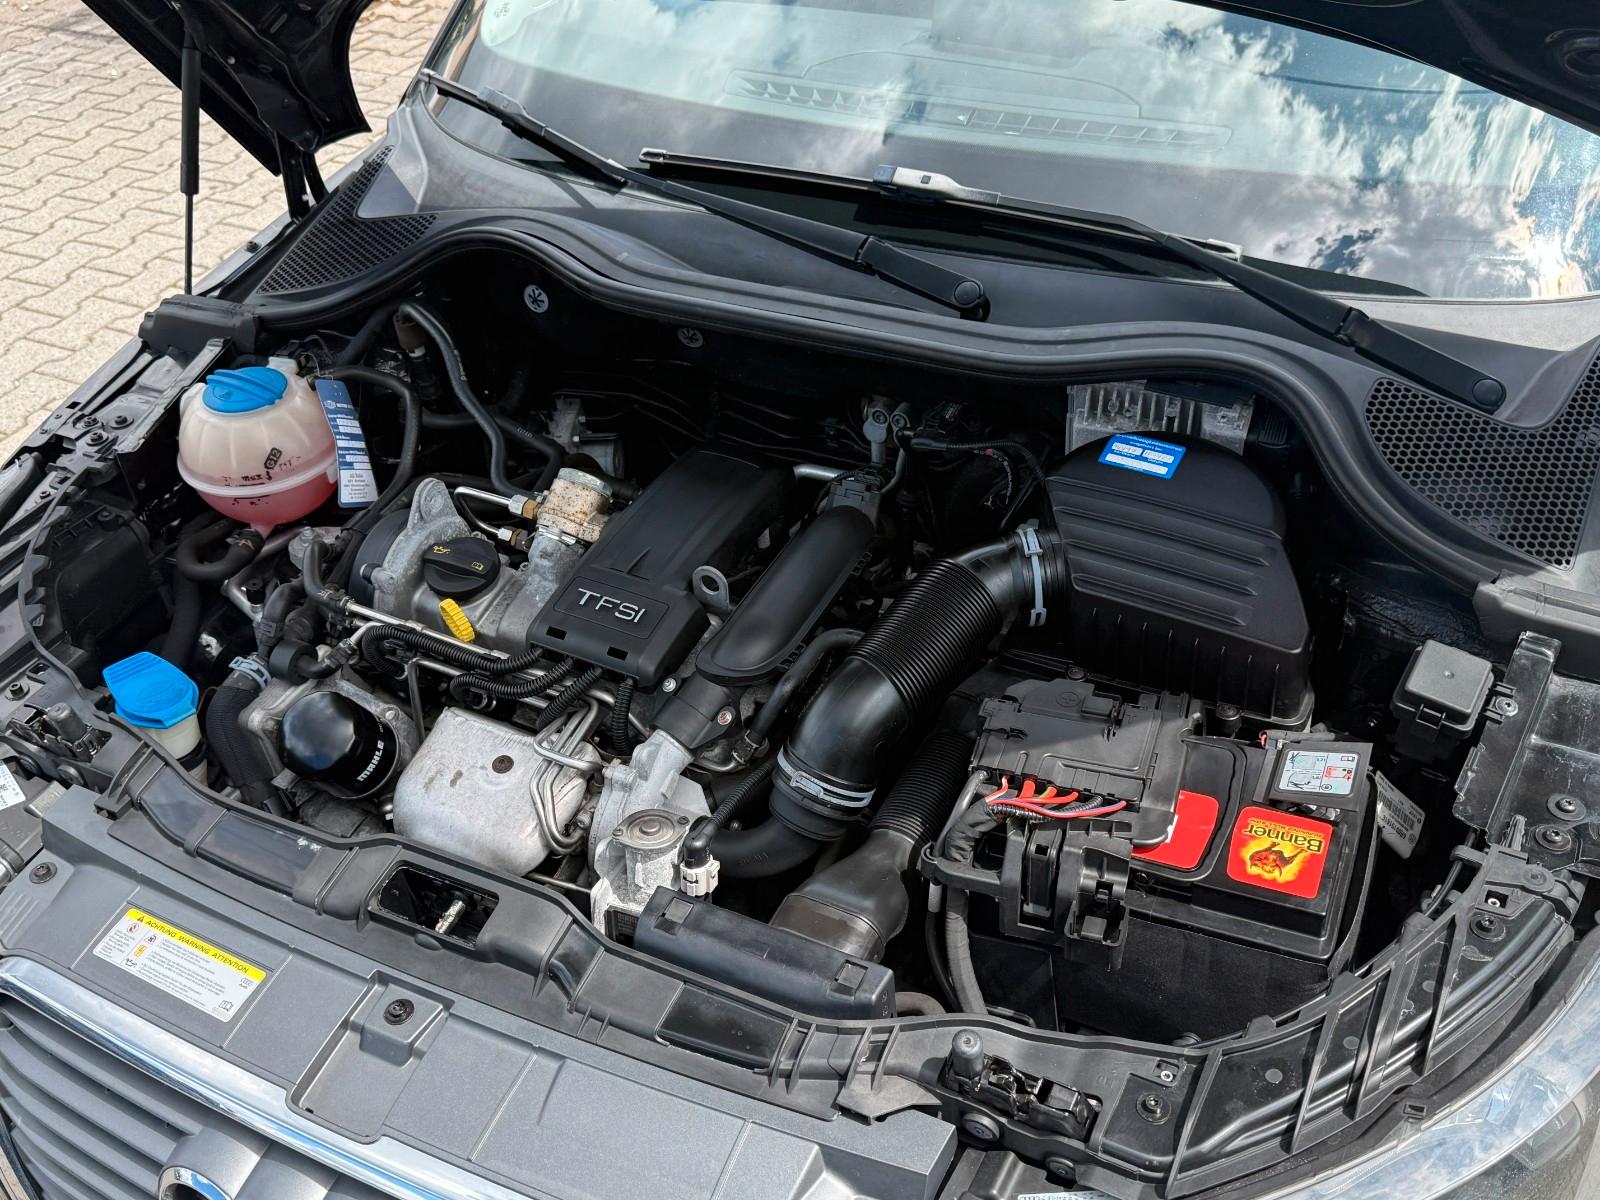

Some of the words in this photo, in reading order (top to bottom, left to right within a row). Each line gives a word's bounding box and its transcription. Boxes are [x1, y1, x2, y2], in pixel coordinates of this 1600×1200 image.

[266, 449, 281, 468] G12
[577, 588, 646, 623] TFSI
[356, 740, 385, 781] MAHLE
[1243, 824, 1324, 853] Banner
[146, 920, 177, 938] ACHTUNG
[179, 935, 210, 955] WARNING
[211, 952, 250, 973] ATTENTION
